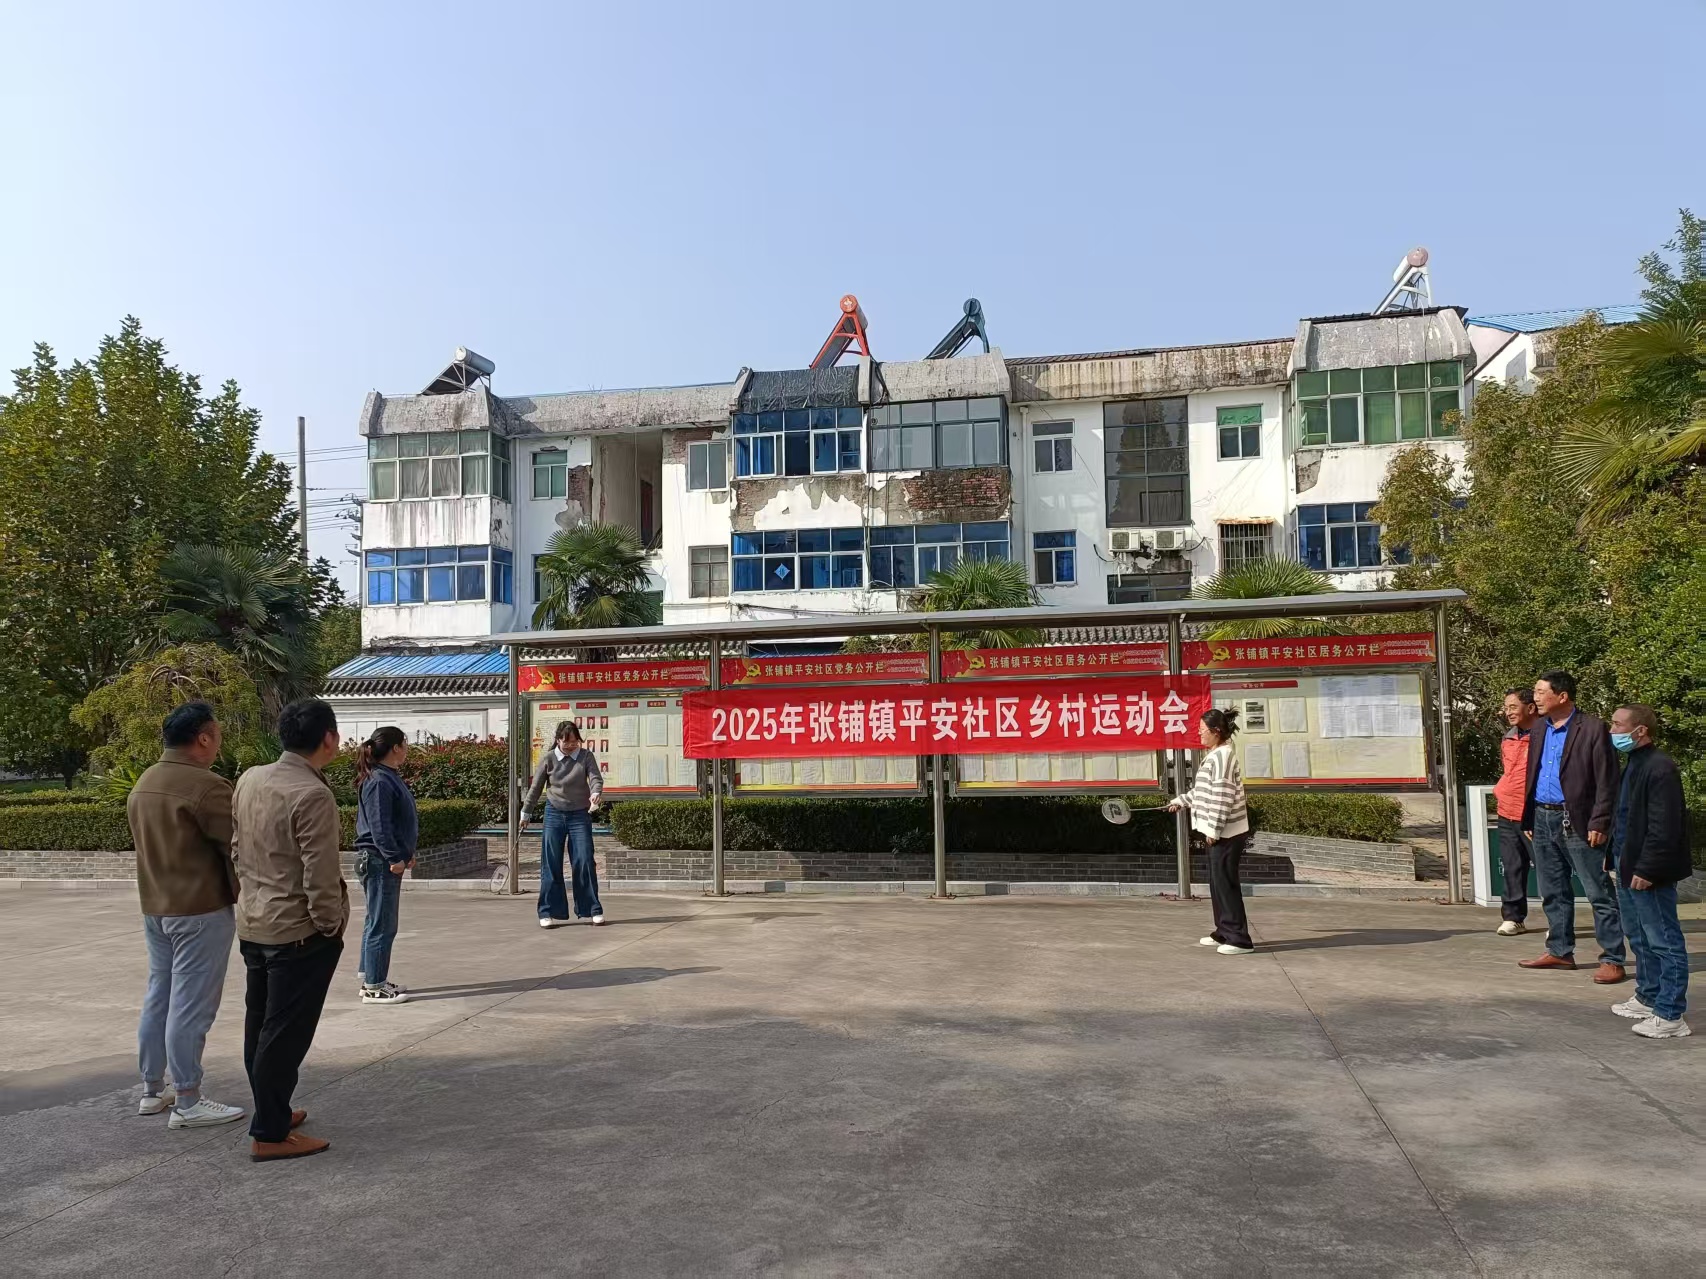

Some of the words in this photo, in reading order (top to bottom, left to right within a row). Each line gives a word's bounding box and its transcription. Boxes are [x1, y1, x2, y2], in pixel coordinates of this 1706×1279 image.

[989, 652, 1120, 669] 张铺镇平安社区居务公开栏
[1235, 643, 1381, 661] 张铺镇平安社区居务公开栏
[558, 669, 669, 684] 张铺镇平安社区党务公开栏
[765, 661, 884, 677] 张铺镇平安社区党务公开栏
[711, 690, 1189, 744] 2025年张铺镇平安社区乡村运动会
